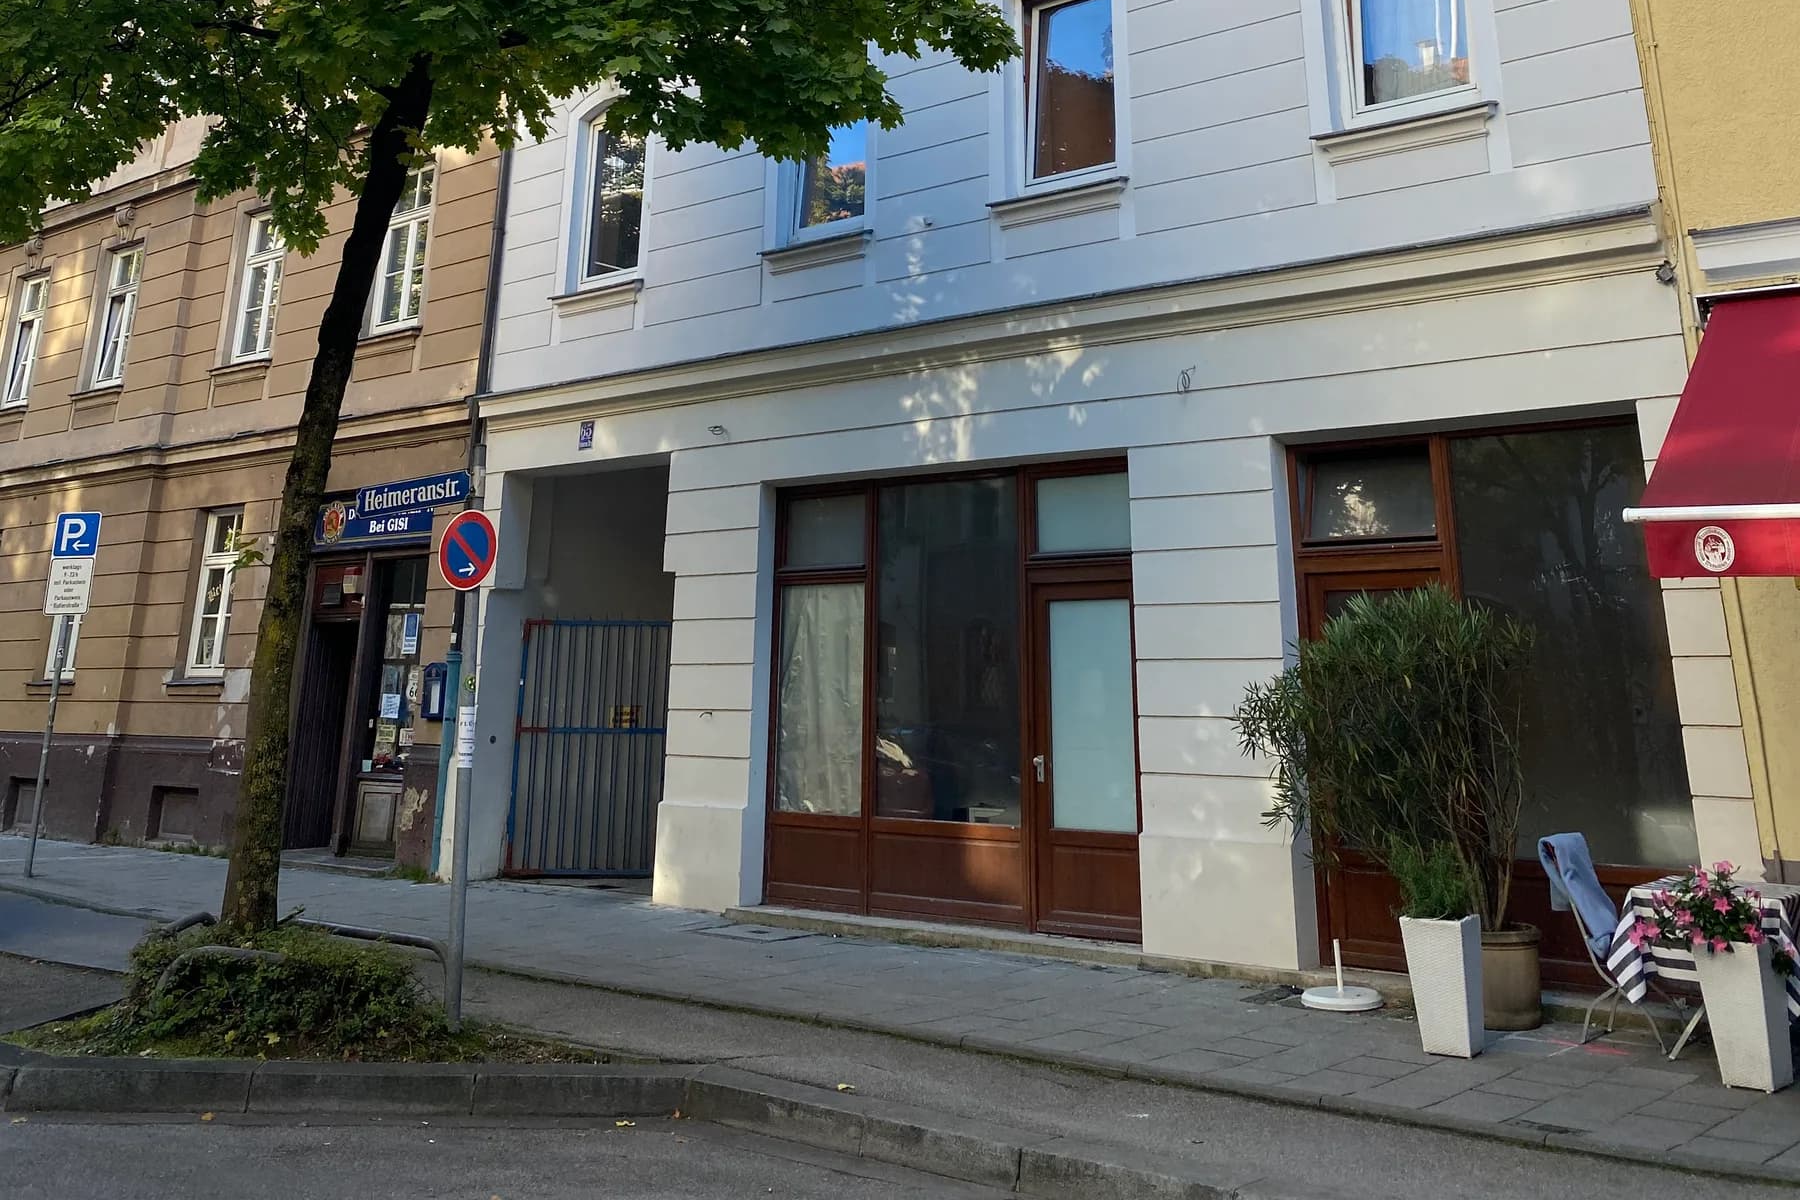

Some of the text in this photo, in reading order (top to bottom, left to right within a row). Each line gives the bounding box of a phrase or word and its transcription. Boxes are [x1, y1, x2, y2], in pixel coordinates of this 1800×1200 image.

[364, 478, 461, 512] Heimeranstr.
[60, 518, 87, 552] P
[369, 517, 409, 534] Bei GISI
